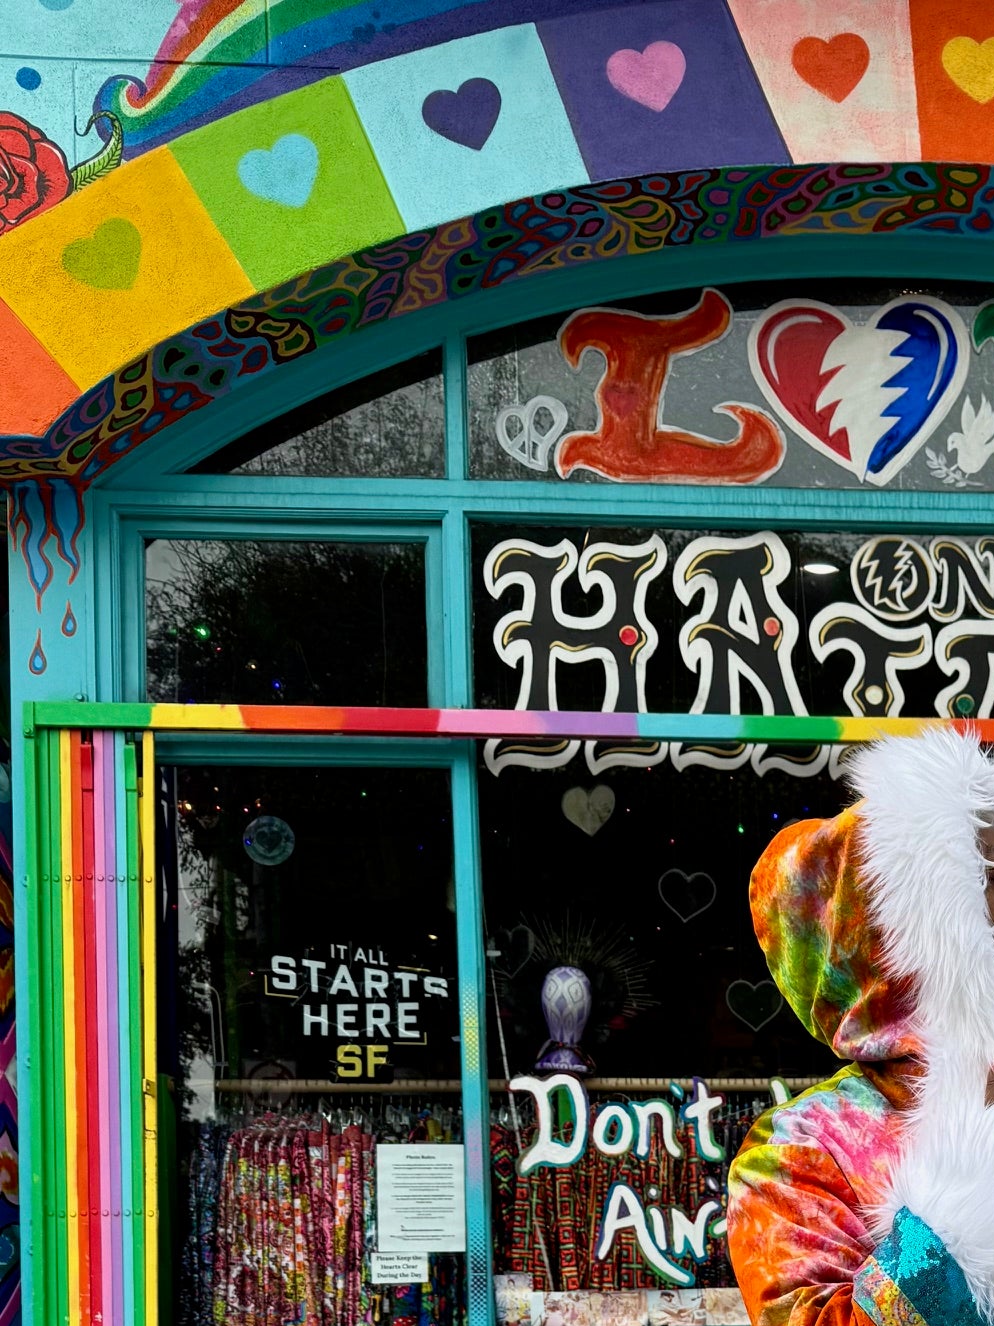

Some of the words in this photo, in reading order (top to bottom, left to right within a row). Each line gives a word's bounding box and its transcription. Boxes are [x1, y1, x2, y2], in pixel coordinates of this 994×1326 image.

[330, 944, 348, 960] IT
[354, 947, 389, 966] ALL
[271, 955, 449, 998] STARTS
[303, 1002, 420, 1038] HERE
[336, 1044, 389, 1078] SF
[506, 1072, 726, 1177] Don't
